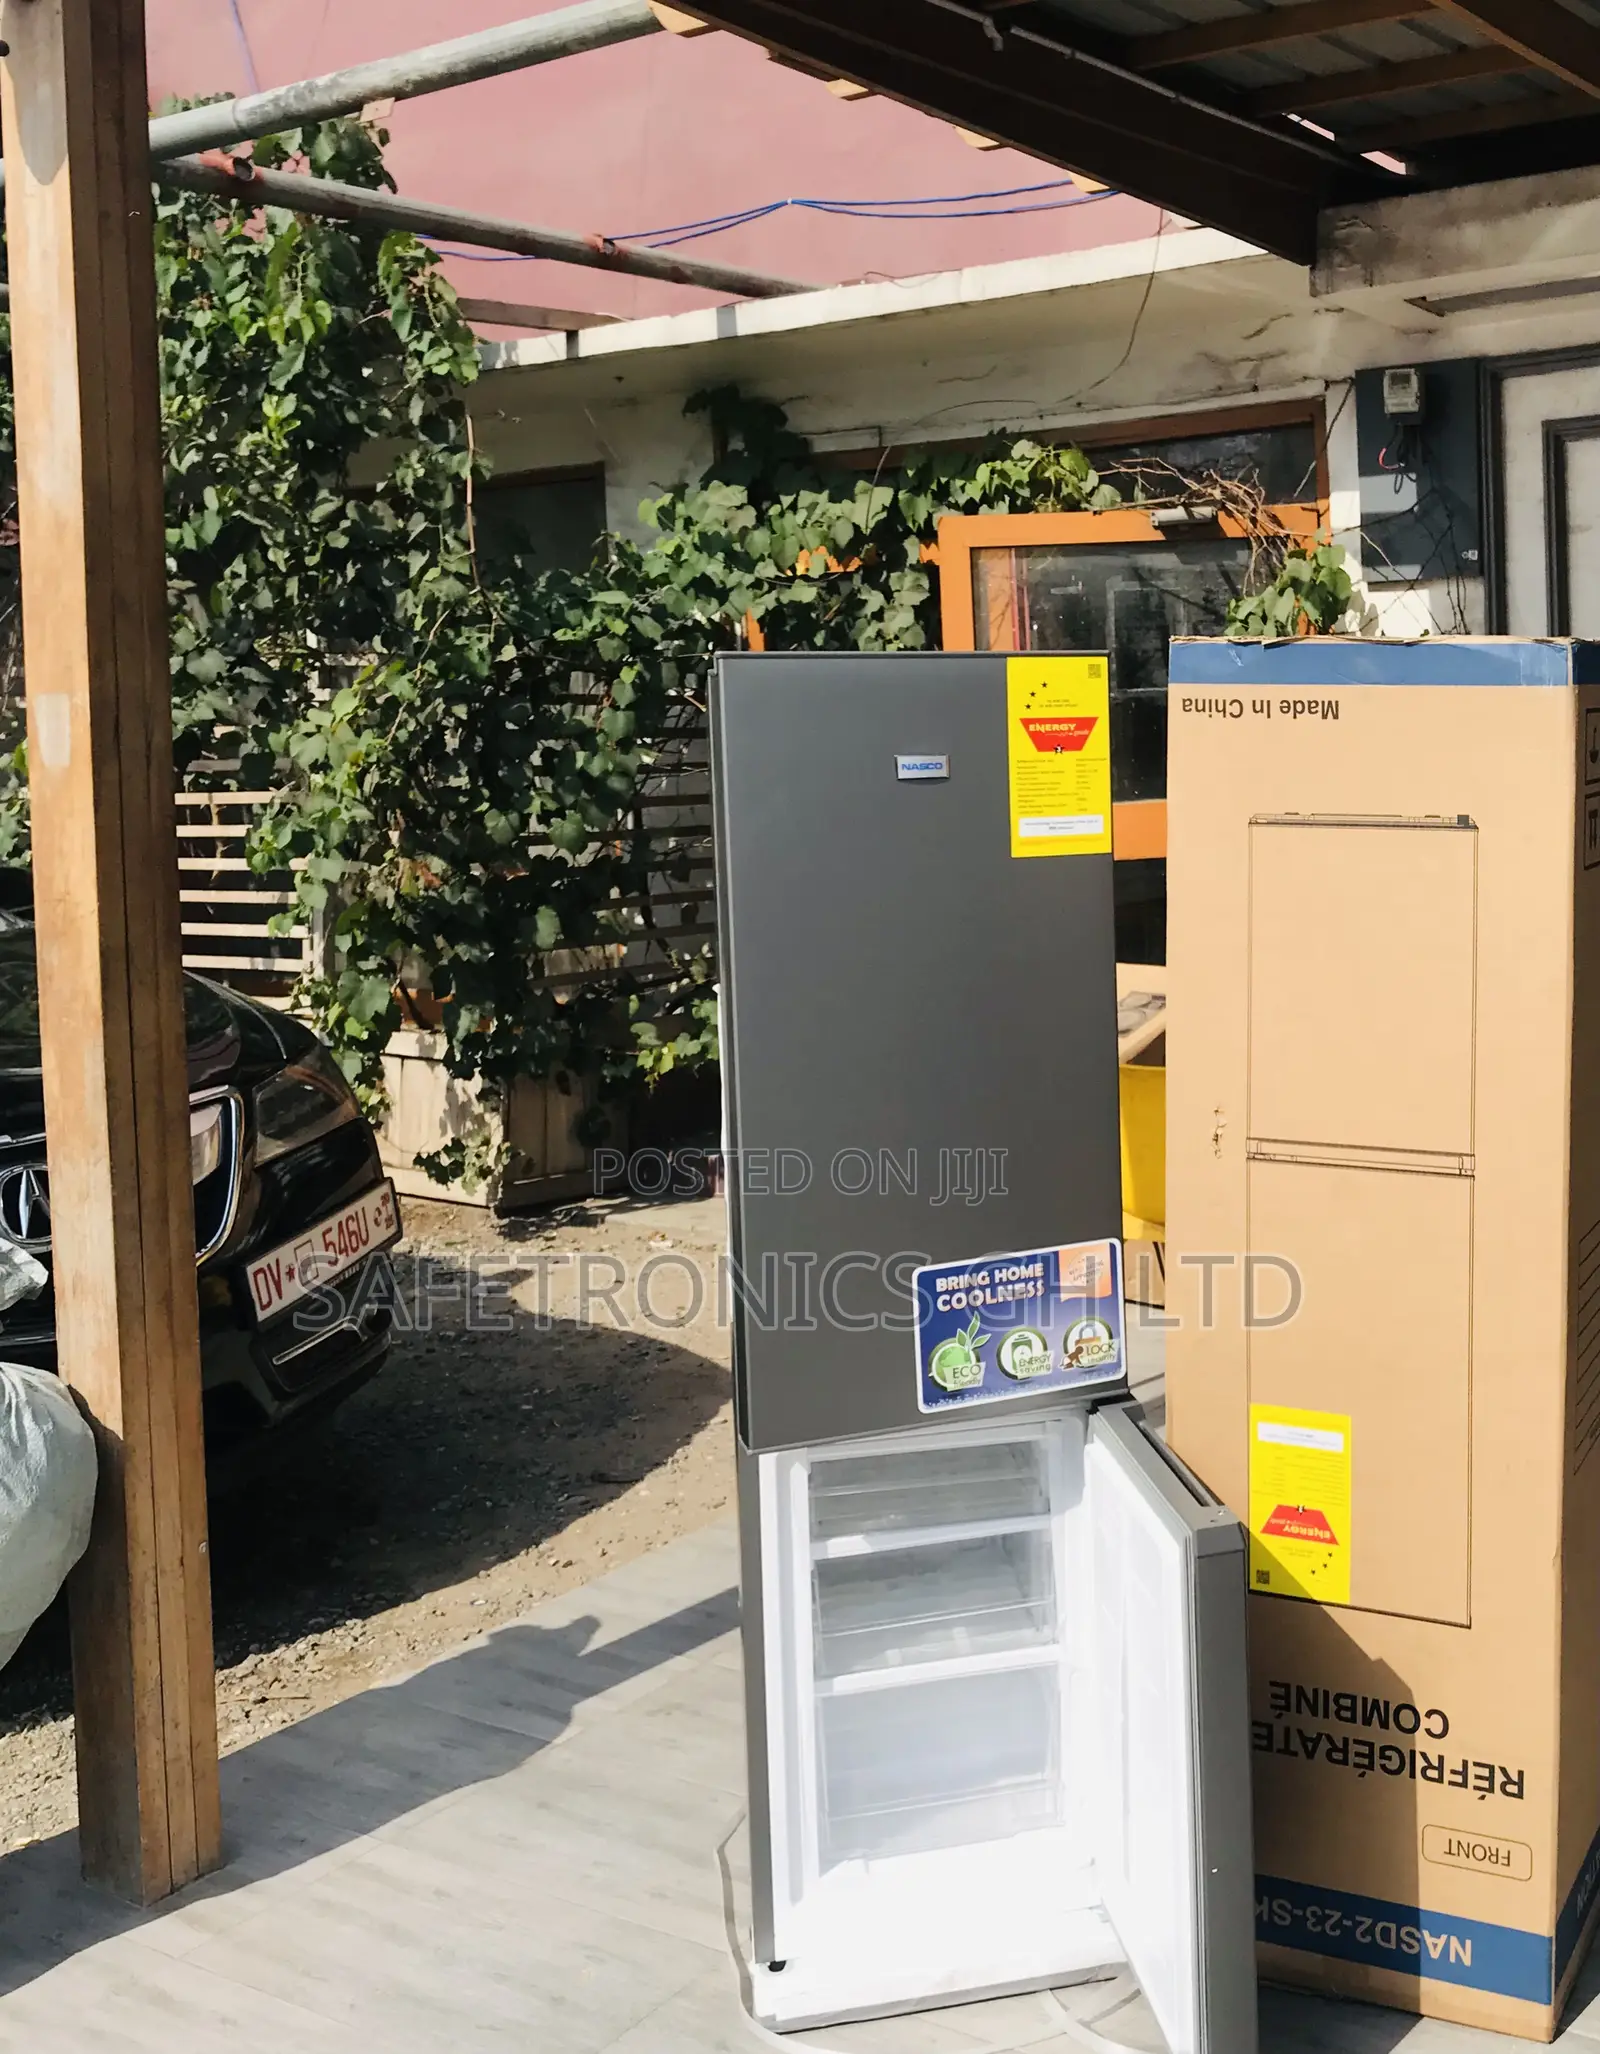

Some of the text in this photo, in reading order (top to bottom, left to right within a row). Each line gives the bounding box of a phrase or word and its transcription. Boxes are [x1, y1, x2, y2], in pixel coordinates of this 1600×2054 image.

[1182, 698, 1340, 720] Made In China
[1029, 723, 1076, 733] ENERGY
[901, 762, 943, 771] NASCO
[252, 1258, 283, 1311] DV
[322, 1206, 370, 1267] 546U
[935, 1272, 990, 1293] BRING
[994, 1263, 1045, 1284] HOME
[936, 1279, 1046, 1312] COOLNESS
[1086, 1341, 1116, 1356] LOCK
[1019, 1353, 1052, 1367] ENERGY
[1020, 1363, 1052, 1374] saving
[952, 1364, 982, 1379] ECO
[1283, 1524, 1331, 1540] ENERGY
[1269, 1680, 1450, 1739] COMBINÉ
[1252, 1719, 1525, 1800] RÉFRIGÉRATE
[1444, 1838, 1511, 1867] FRONT
